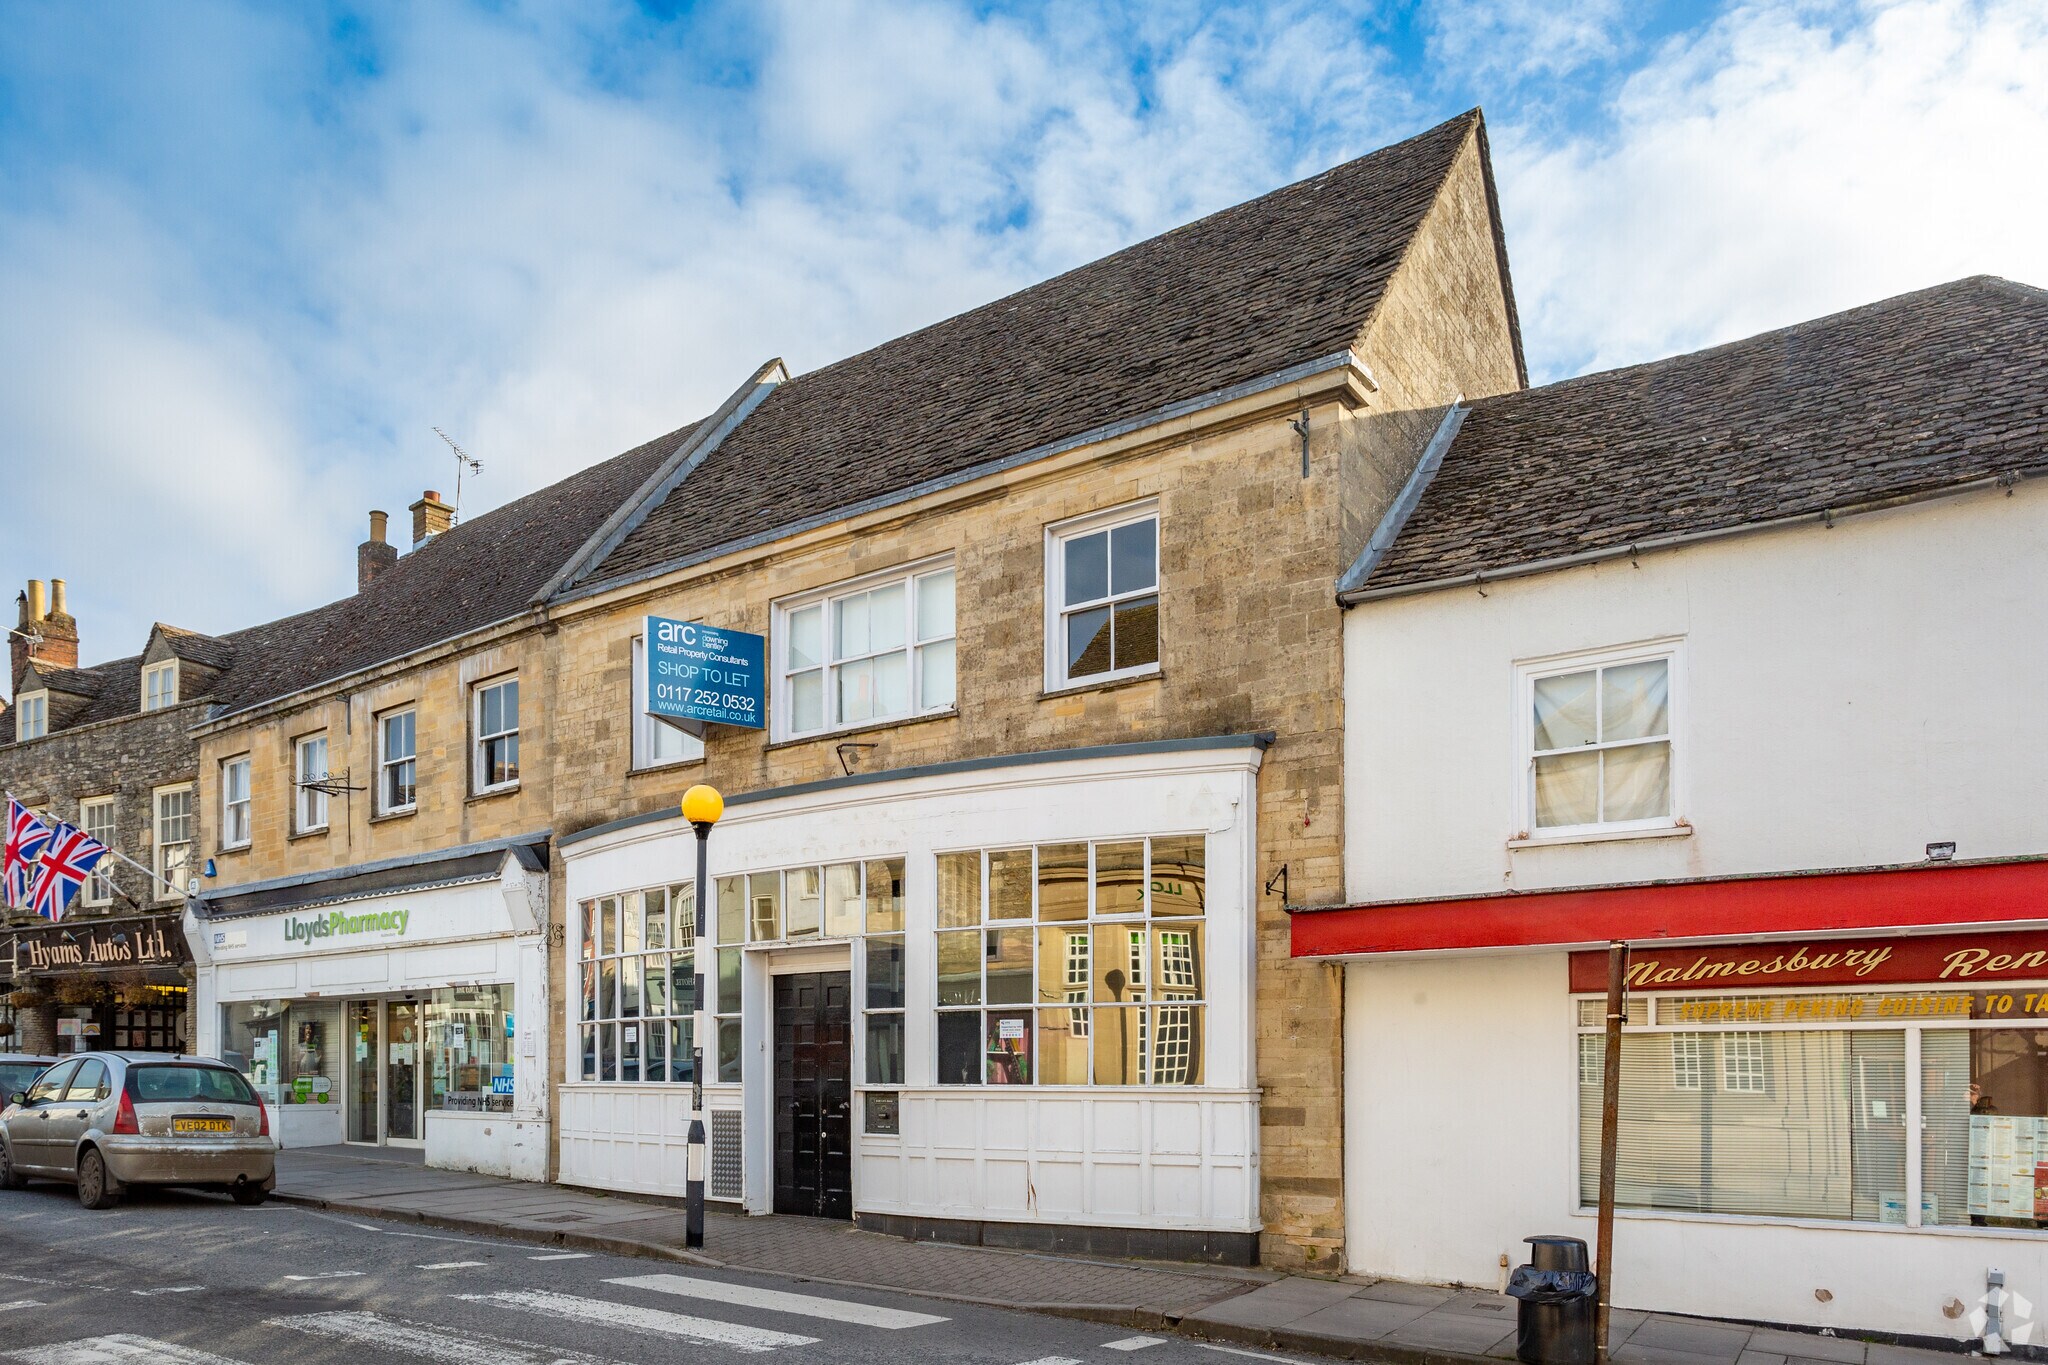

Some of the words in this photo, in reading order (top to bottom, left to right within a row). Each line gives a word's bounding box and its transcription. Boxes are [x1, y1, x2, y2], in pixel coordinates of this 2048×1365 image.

[658, 622, 697, 645] arc
[702, 634, 728, 647] downing
[657, 643, 678, 655] Retail
[678, 646, 709, 661] Property
[709, 652, 749, 666] Consultants
[702, 641, 725, 652] bentley
[658, 660, 699, 679] SHOP
[702, 668, 722, 684] TO
[724, 672, 750, 688] LET
[657, 684, 691, 702] 0117
[694, 689, 720, 707] 252
[722, 693, 755, 712] 0532
[657, 700, 756, 723] www.arcretail.co.uk
[214, 933, 225, 943] NHS
[284, 909, 410, 946] LloydsPharmacy
[28, 940, 83, 970] Hyams
[87, 935, 132, 963] Autos
[135, 930, 172, 960] Ltd.
[1938, 948, 2048, 979] Ren
[1680, 1000, 1776, 1021] SUPREME
[1783, 998, 1865, 1019] PEKING
[1877, 996, 1975, 1017] CUISINE
[1985, 994, 2014, 1014] TO
[493, 1077, 514, 1094] NHS
[447, 1095, 476, 1108] Providing
[477, 1096, 490, 1107] NHS
[181, 1119, 207, 1131] VE02
[209, 1119, 228, 1130] DTK
